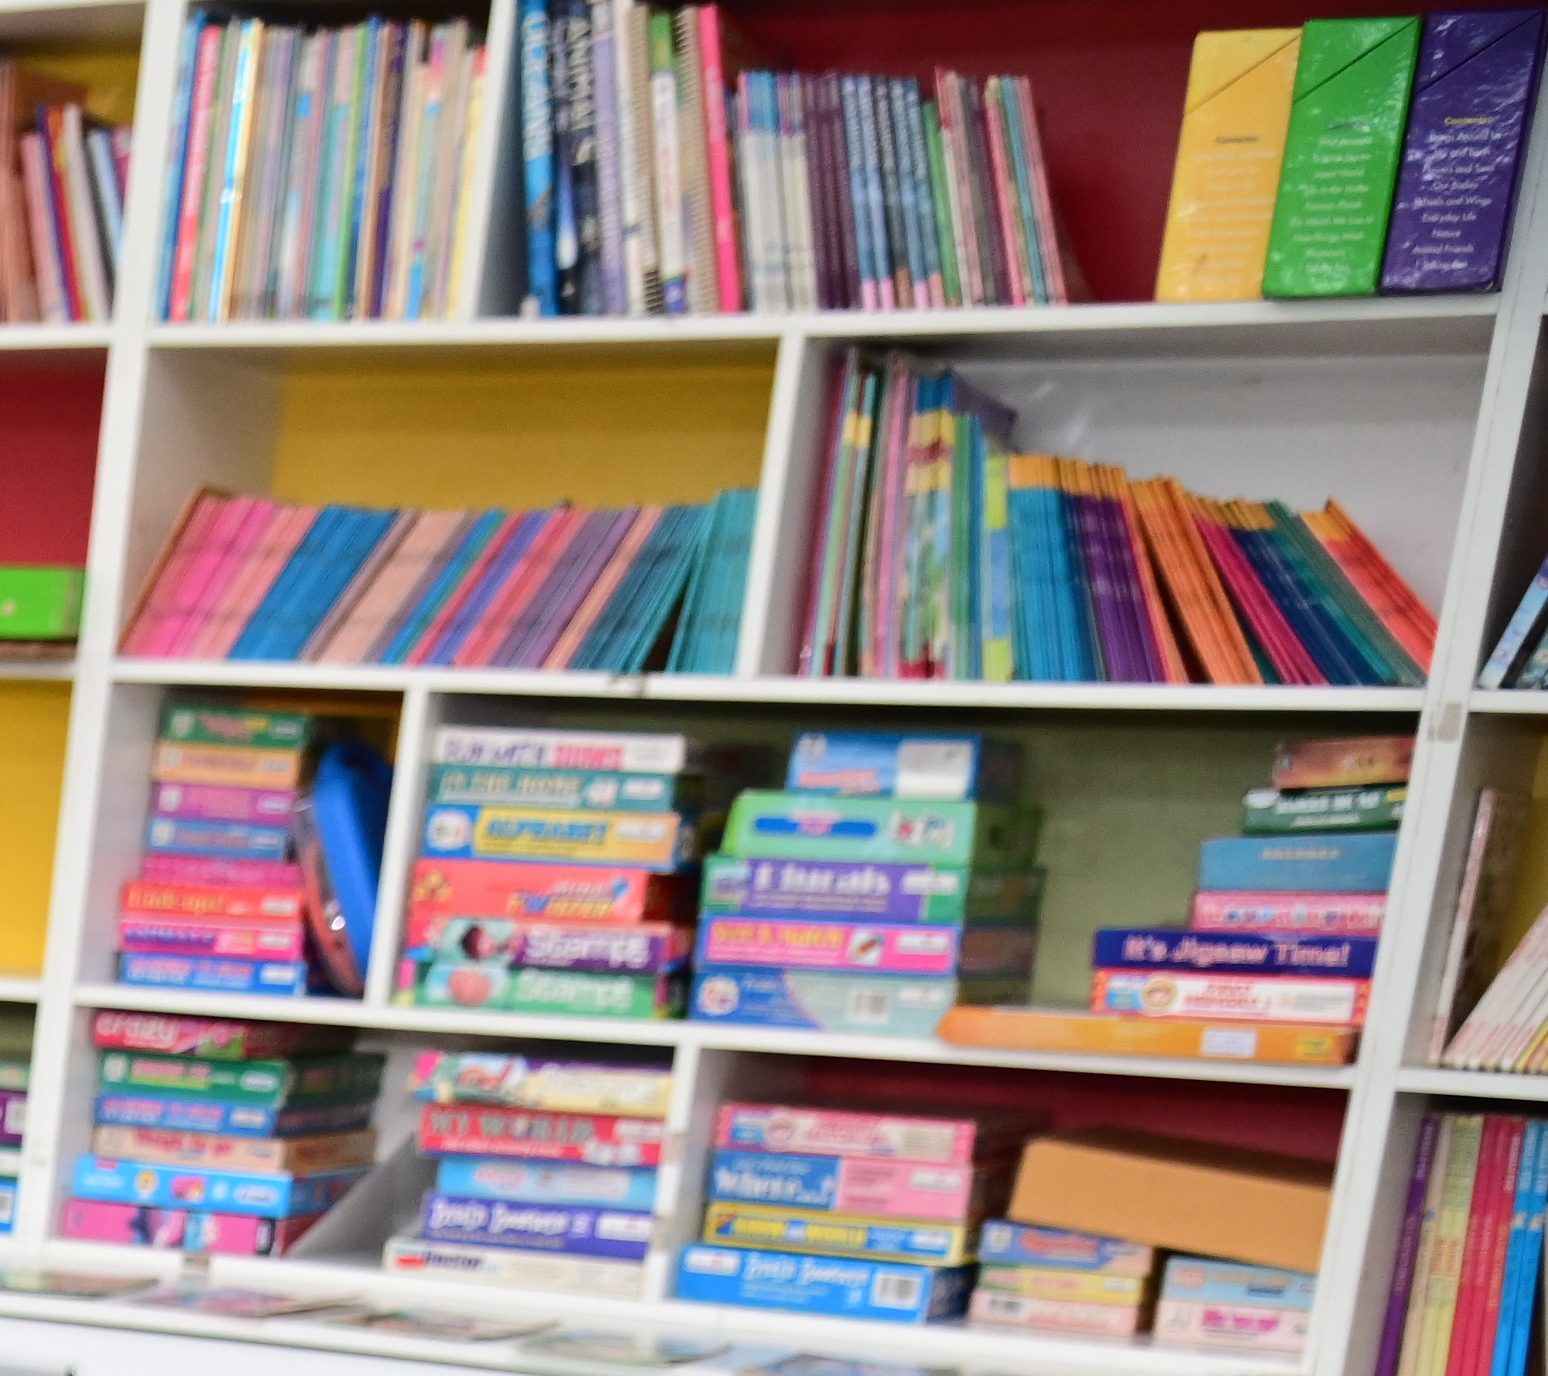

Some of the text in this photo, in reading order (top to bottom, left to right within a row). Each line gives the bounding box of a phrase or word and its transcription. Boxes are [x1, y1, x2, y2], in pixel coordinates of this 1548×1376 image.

[1122, 933, 1352, 969] It's Jigsaw Time!
